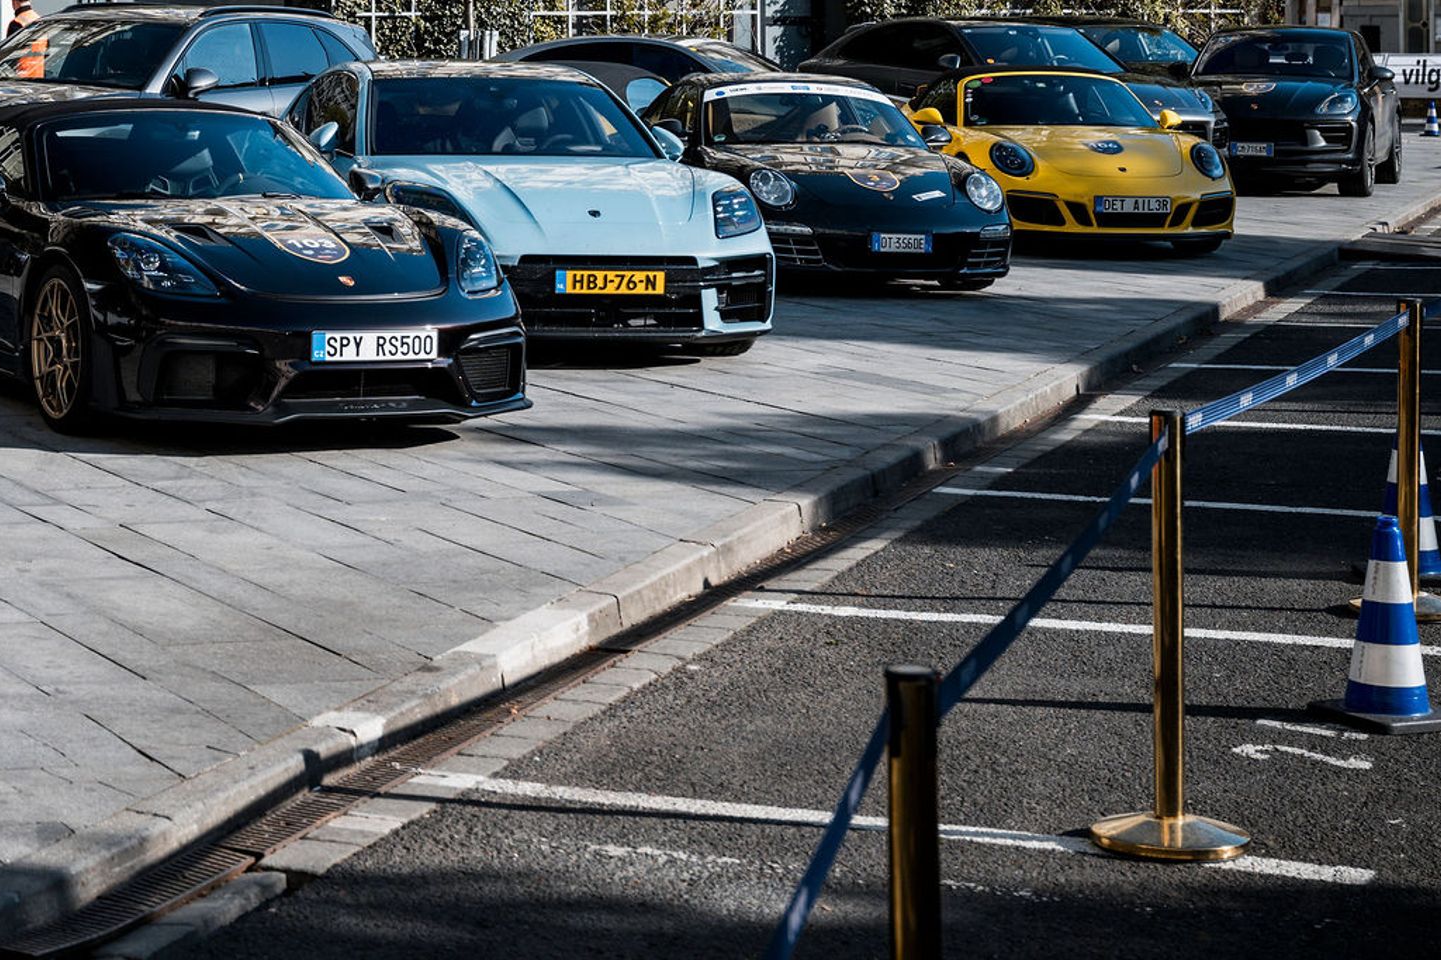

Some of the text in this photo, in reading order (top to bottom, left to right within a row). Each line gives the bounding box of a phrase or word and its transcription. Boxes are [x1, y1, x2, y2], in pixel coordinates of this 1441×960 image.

[1104, 198, 1126, 211] DET
[572, 273, 657, 291] HBJ-76-N
[326, 335, 433, 357] SPY RS500
